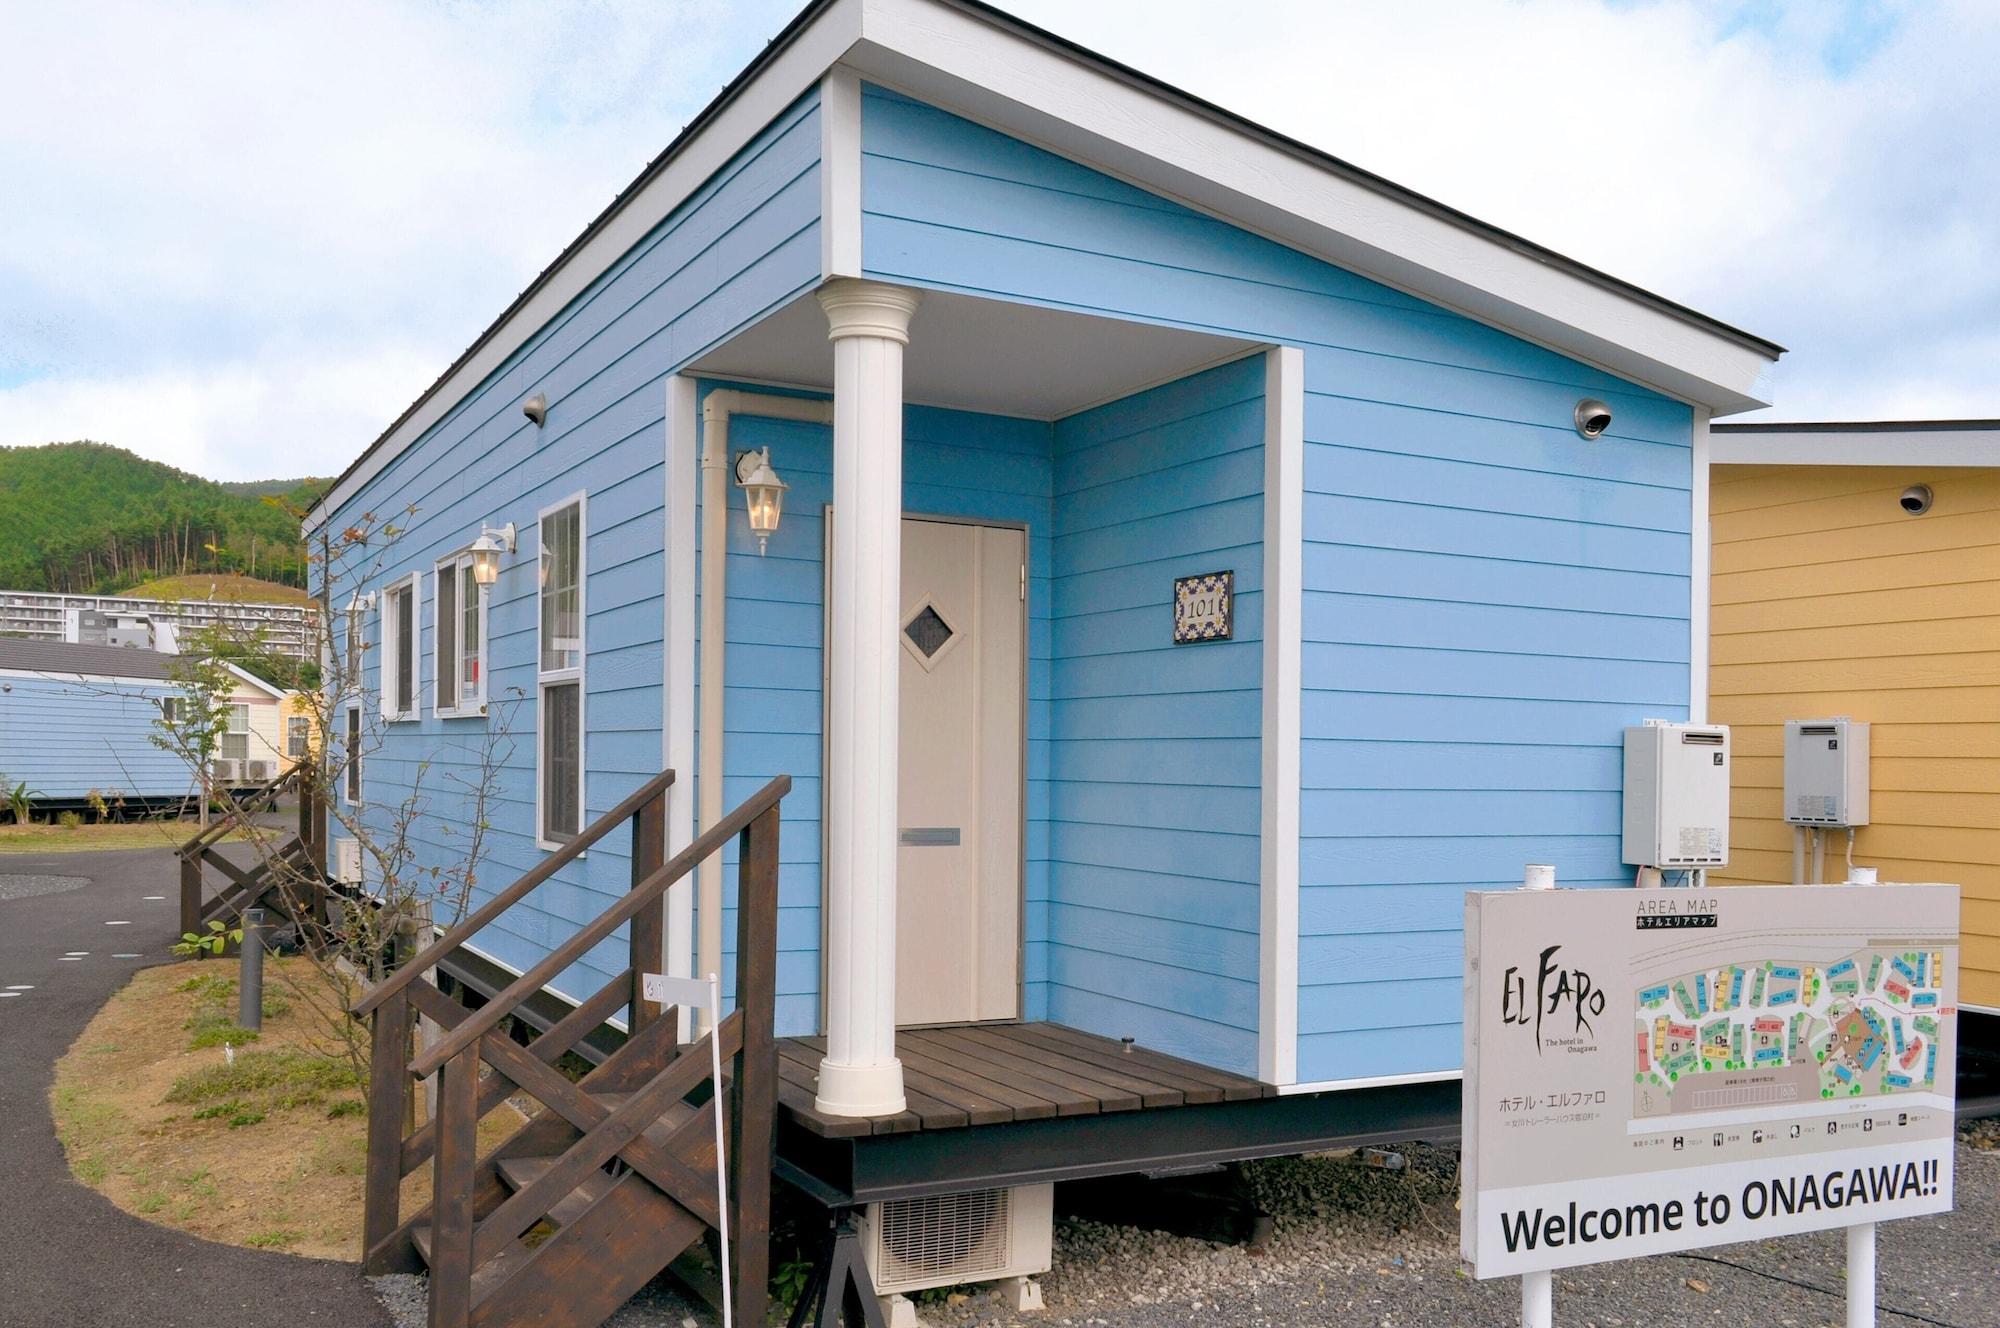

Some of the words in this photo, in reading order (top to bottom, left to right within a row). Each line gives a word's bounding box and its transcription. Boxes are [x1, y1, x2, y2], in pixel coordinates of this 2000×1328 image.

[1187, 597, 1215, 619] 101
[1637, 900, 1677, 914] AREA
[1687, 899, 1718, 913] MAP
[1637, 915, 1717, 928] ホテルエリアマップ
[1545, 1039, 1558, 1047] The
[1559, 1037, 1576, 1046] hotel
[1577, 1037, 1584, 1045] in
[1567, 1045, 1597, 1054] Onagawa
[1499, 1090, 1606, 1113] ホテル・エルファロ
[1501, 1201, 1683, 1252] Welcome
[1694, 1191, 1731, 1227] to
[1742, 1159, 1938, 1220] ONAGAWA!!
